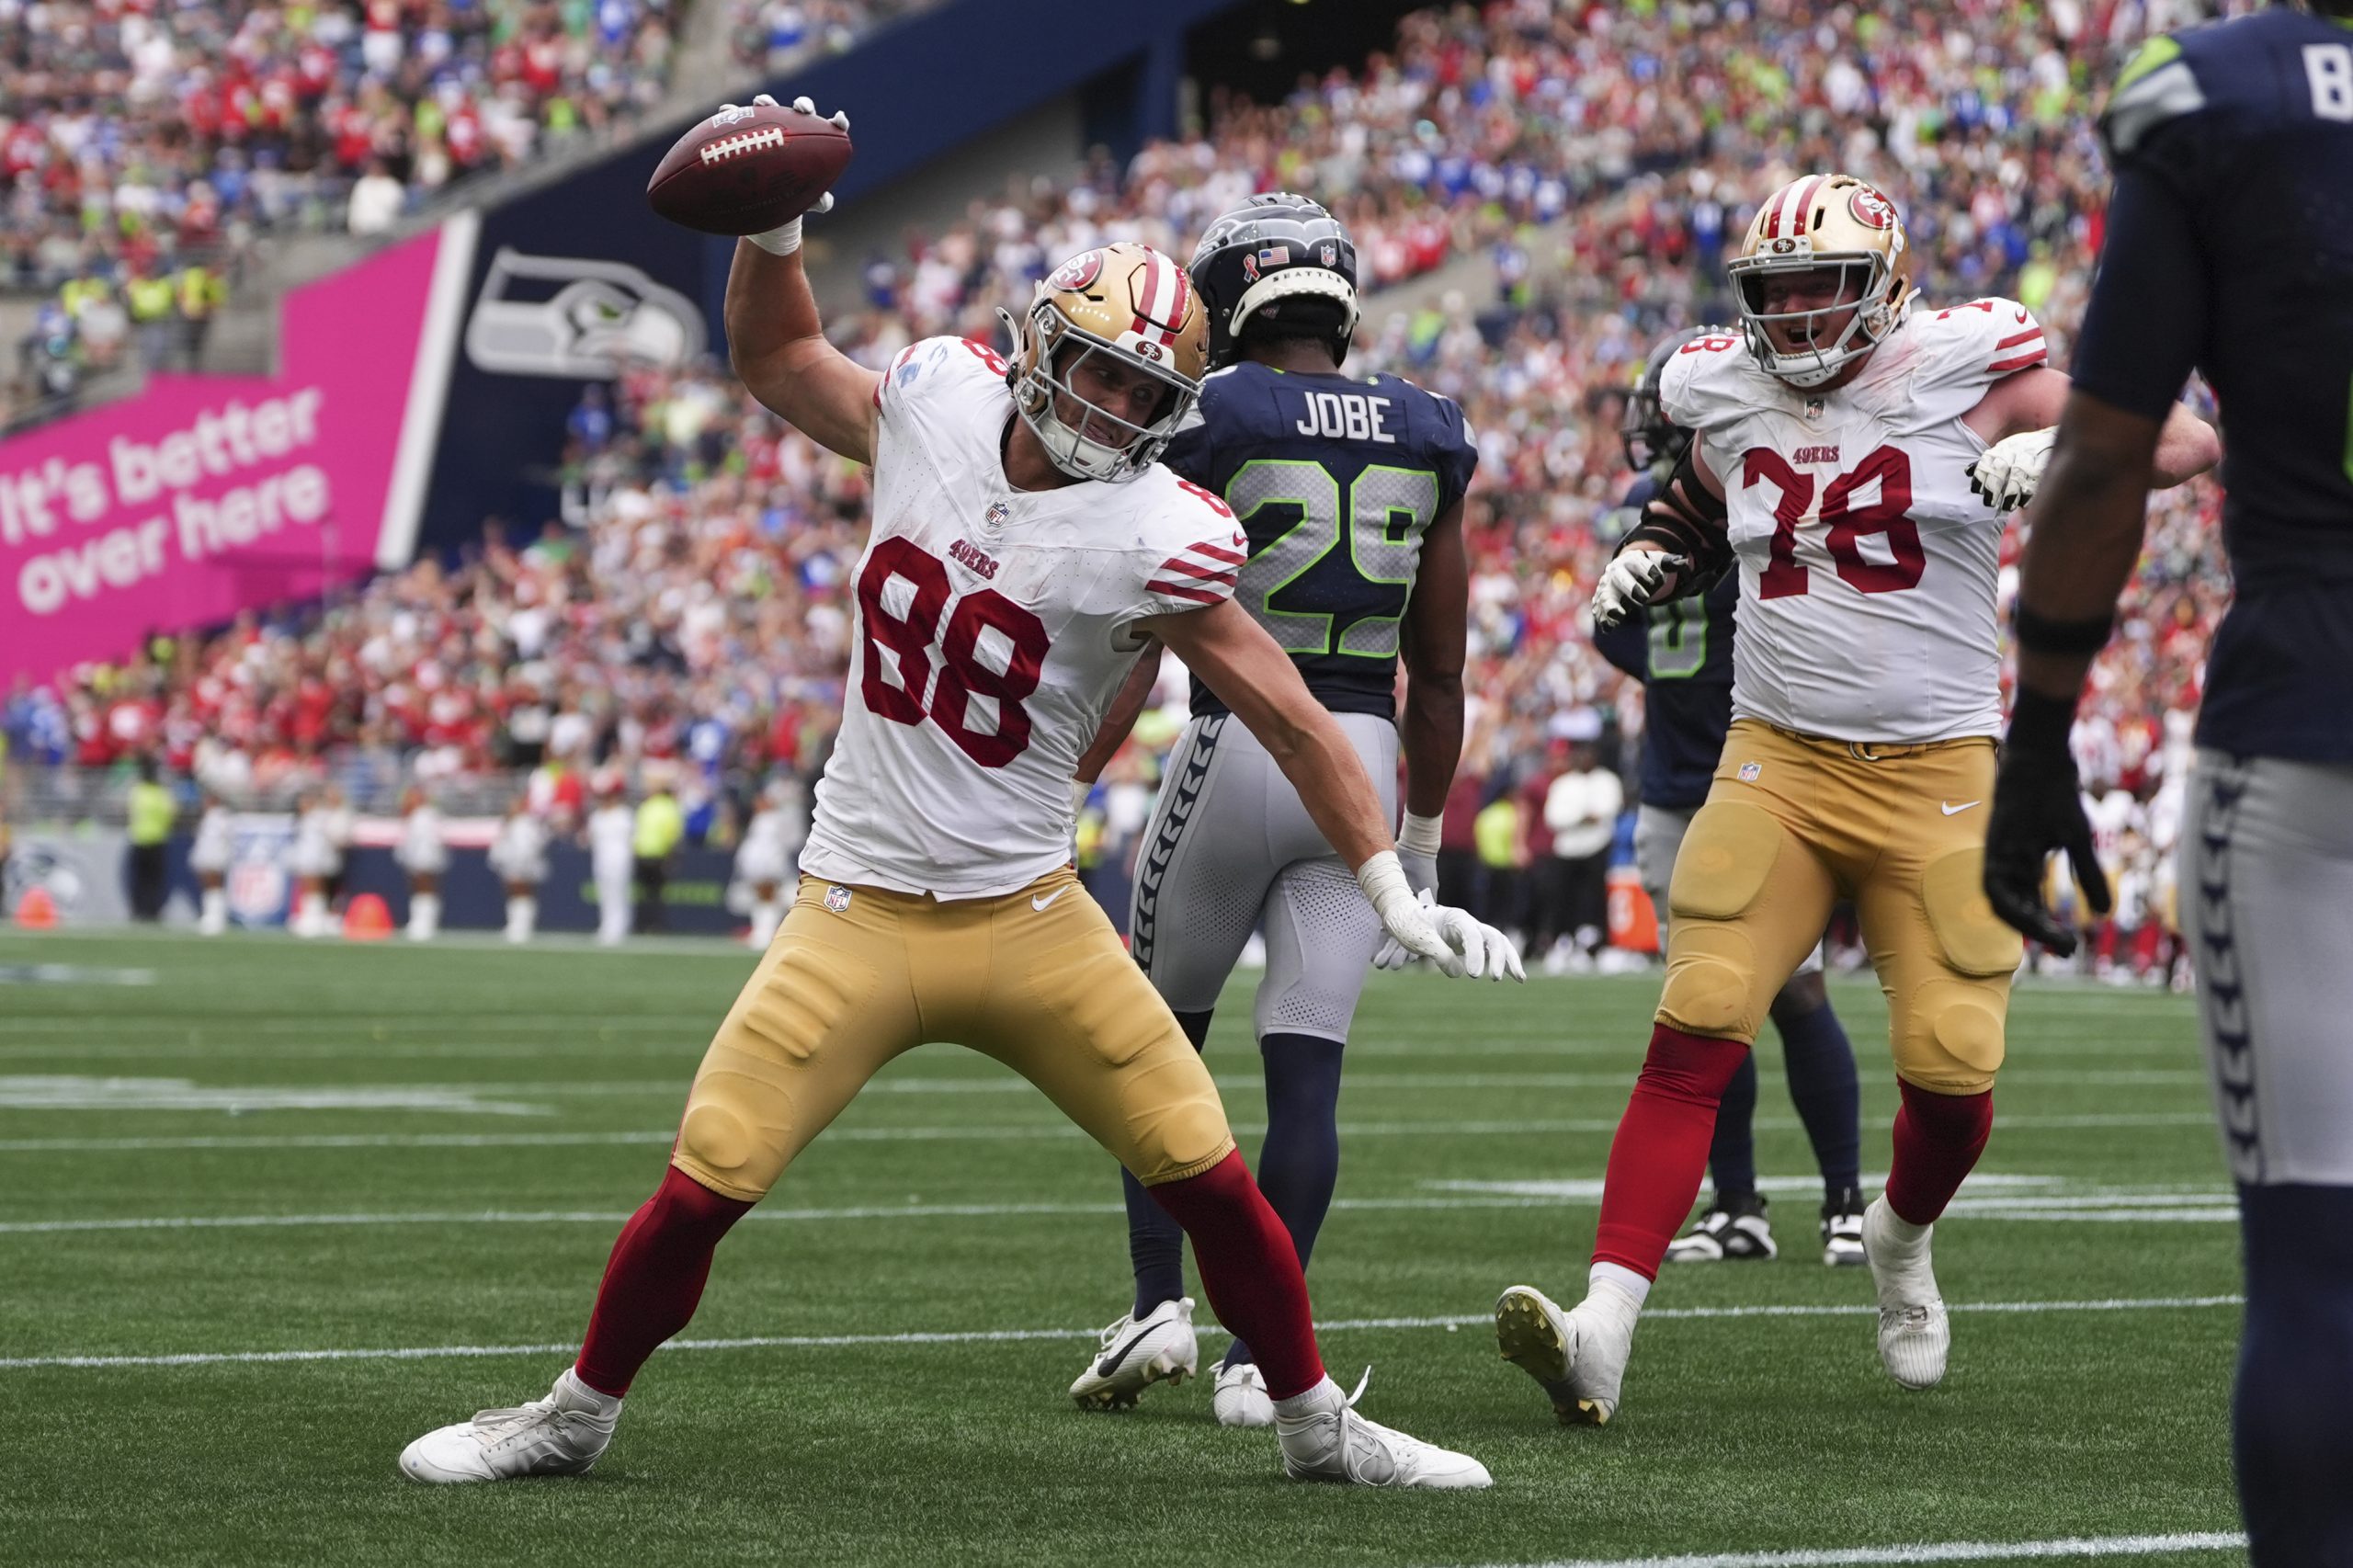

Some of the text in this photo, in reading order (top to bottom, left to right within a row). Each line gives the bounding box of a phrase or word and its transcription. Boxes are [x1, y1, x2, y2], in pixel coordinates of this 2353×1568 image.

[1272, 269, 1342, 284] SEATTLE
[0, 387, 321, 543] It's better
[1296, 391, 1395, 443] JOBE
[1792, 445, 1840, 464] 49ERS
[19, 464, 328, 614] over here
[949, 539, 1000, 580] 49ERS
[1224, 460, 1439, 659] 29
[1743, 444, 1927, 600] 78
[858, 535, 1051, 767] 88
